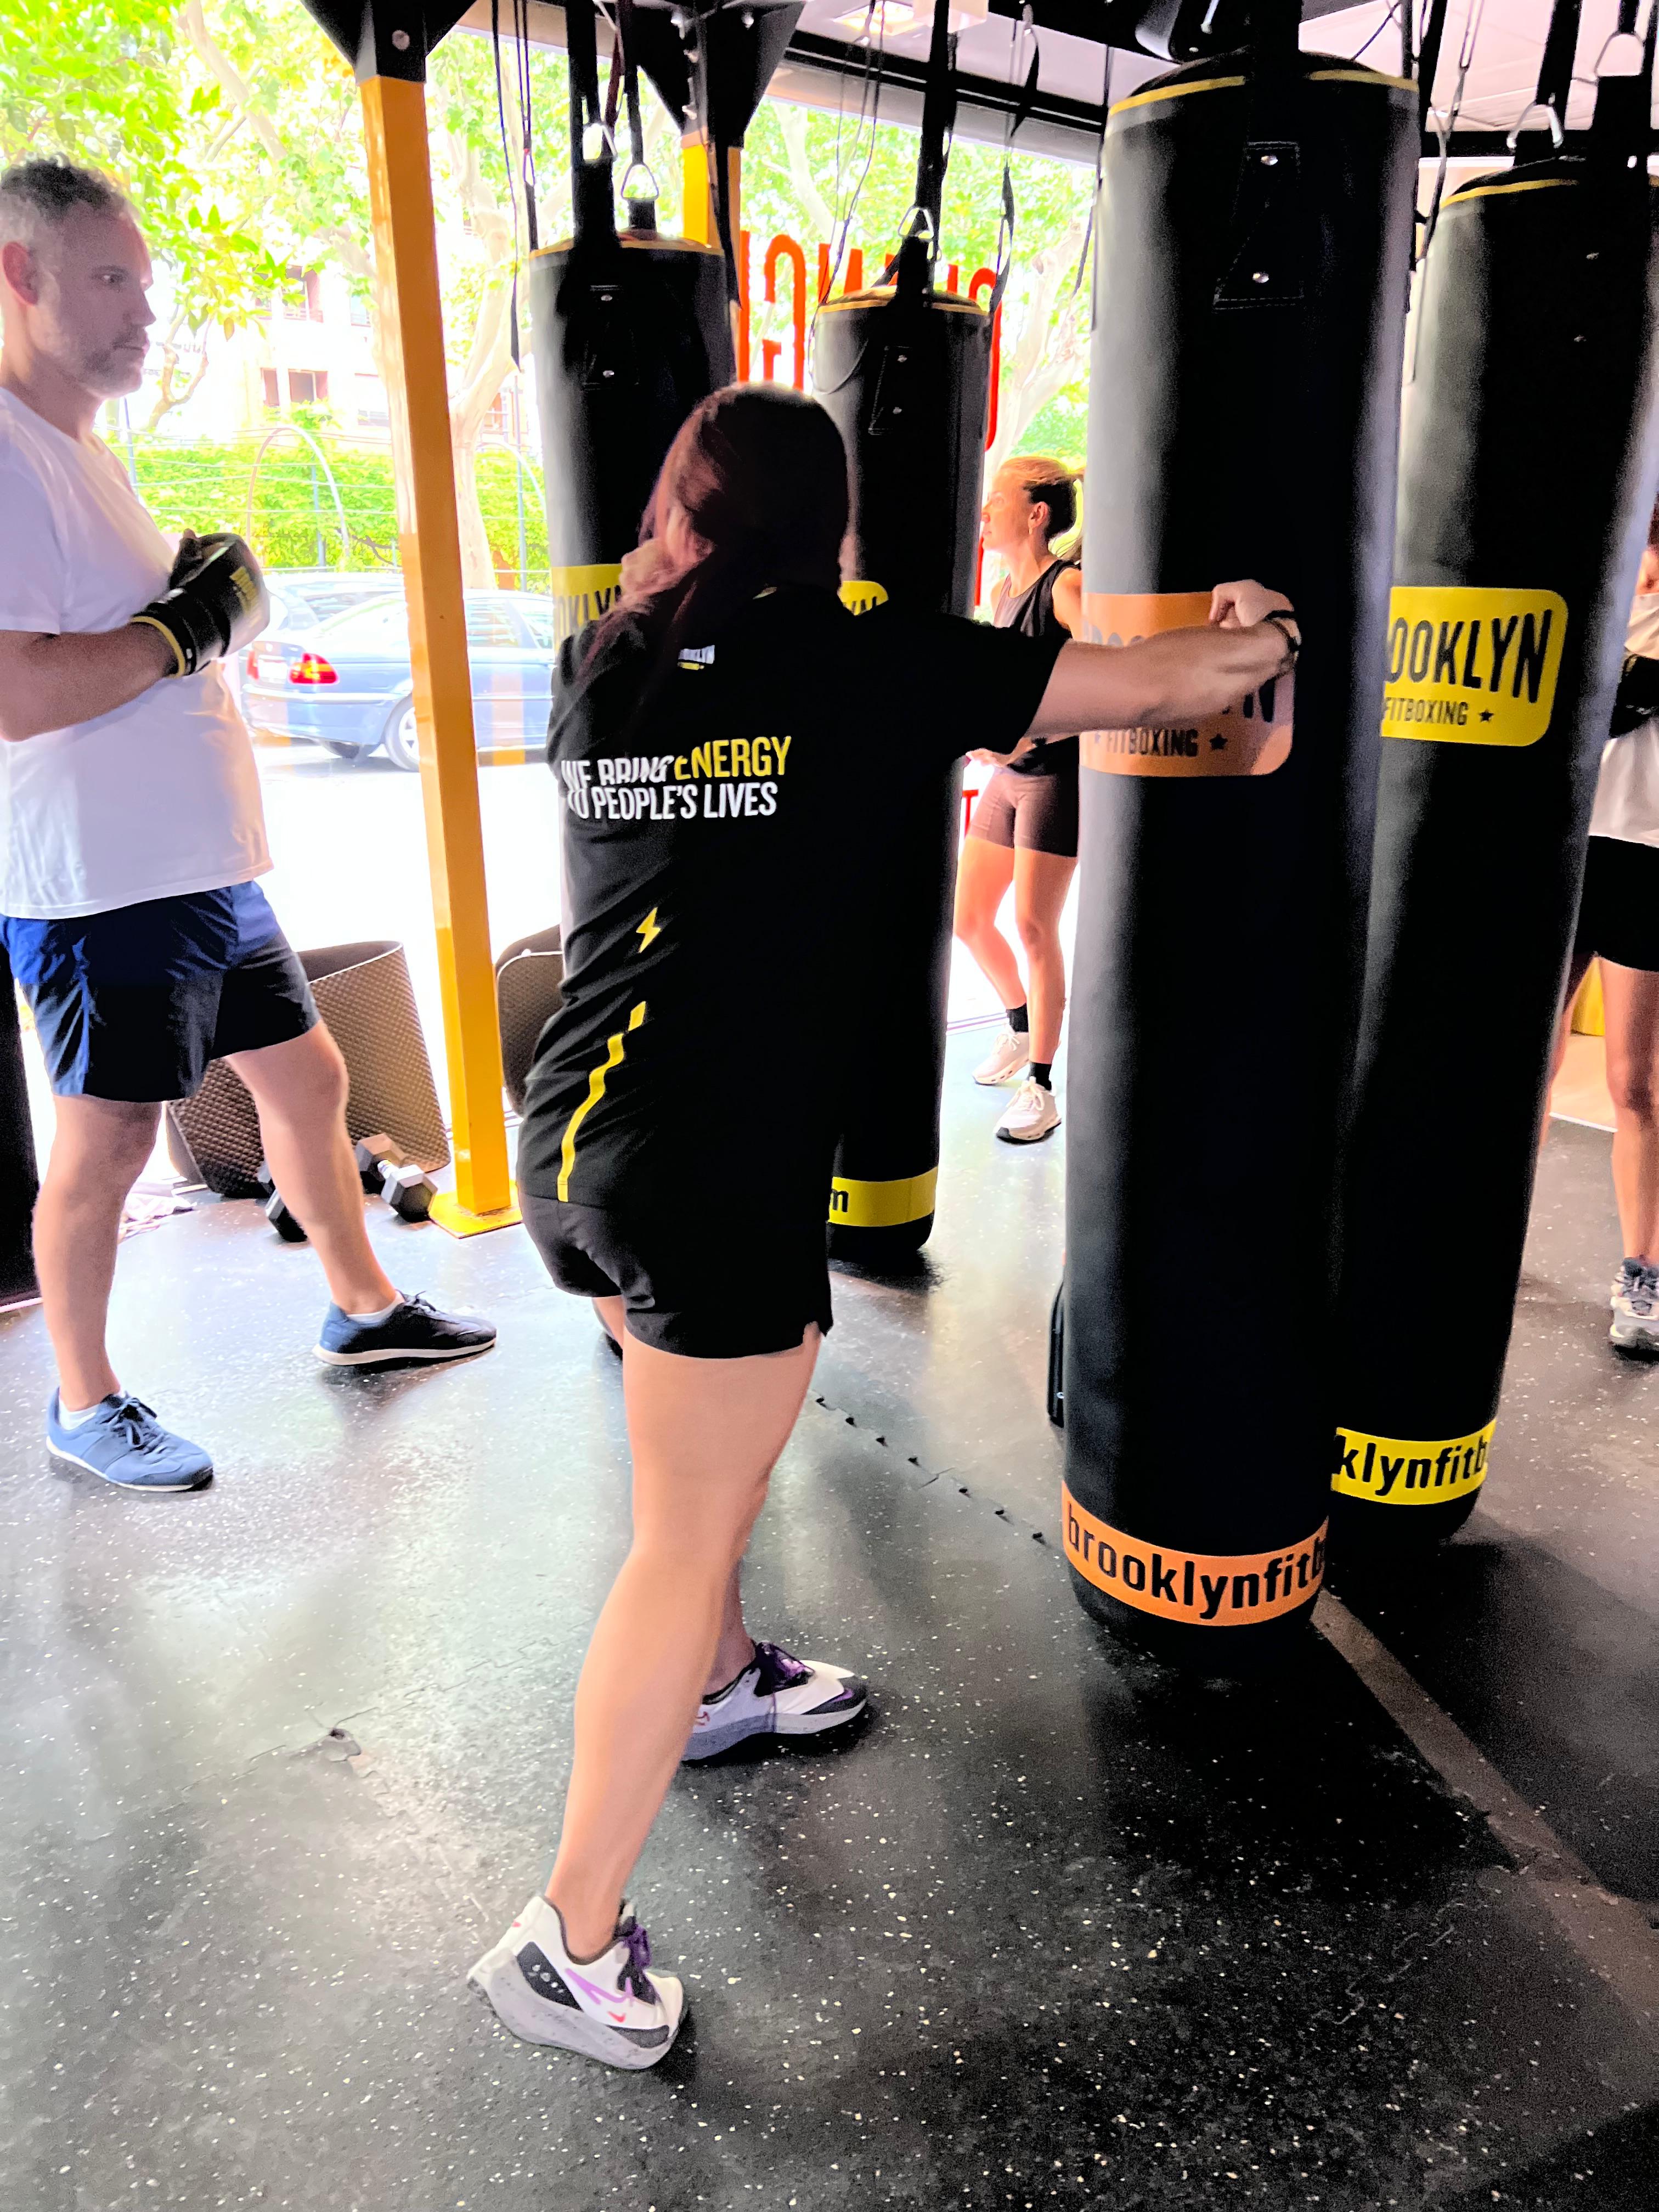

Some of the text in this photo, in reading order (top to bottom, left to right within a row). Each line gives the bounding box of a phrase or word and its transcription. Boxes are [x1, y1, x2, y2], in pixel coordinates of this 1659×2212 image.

[674, 736, 792, 780] ENERGY
[1106, 729, 1199, 757] FITBOXING
[591, 783, 698, 820] PEOPLE'S
[703, 781, 778, 819] LIVES
